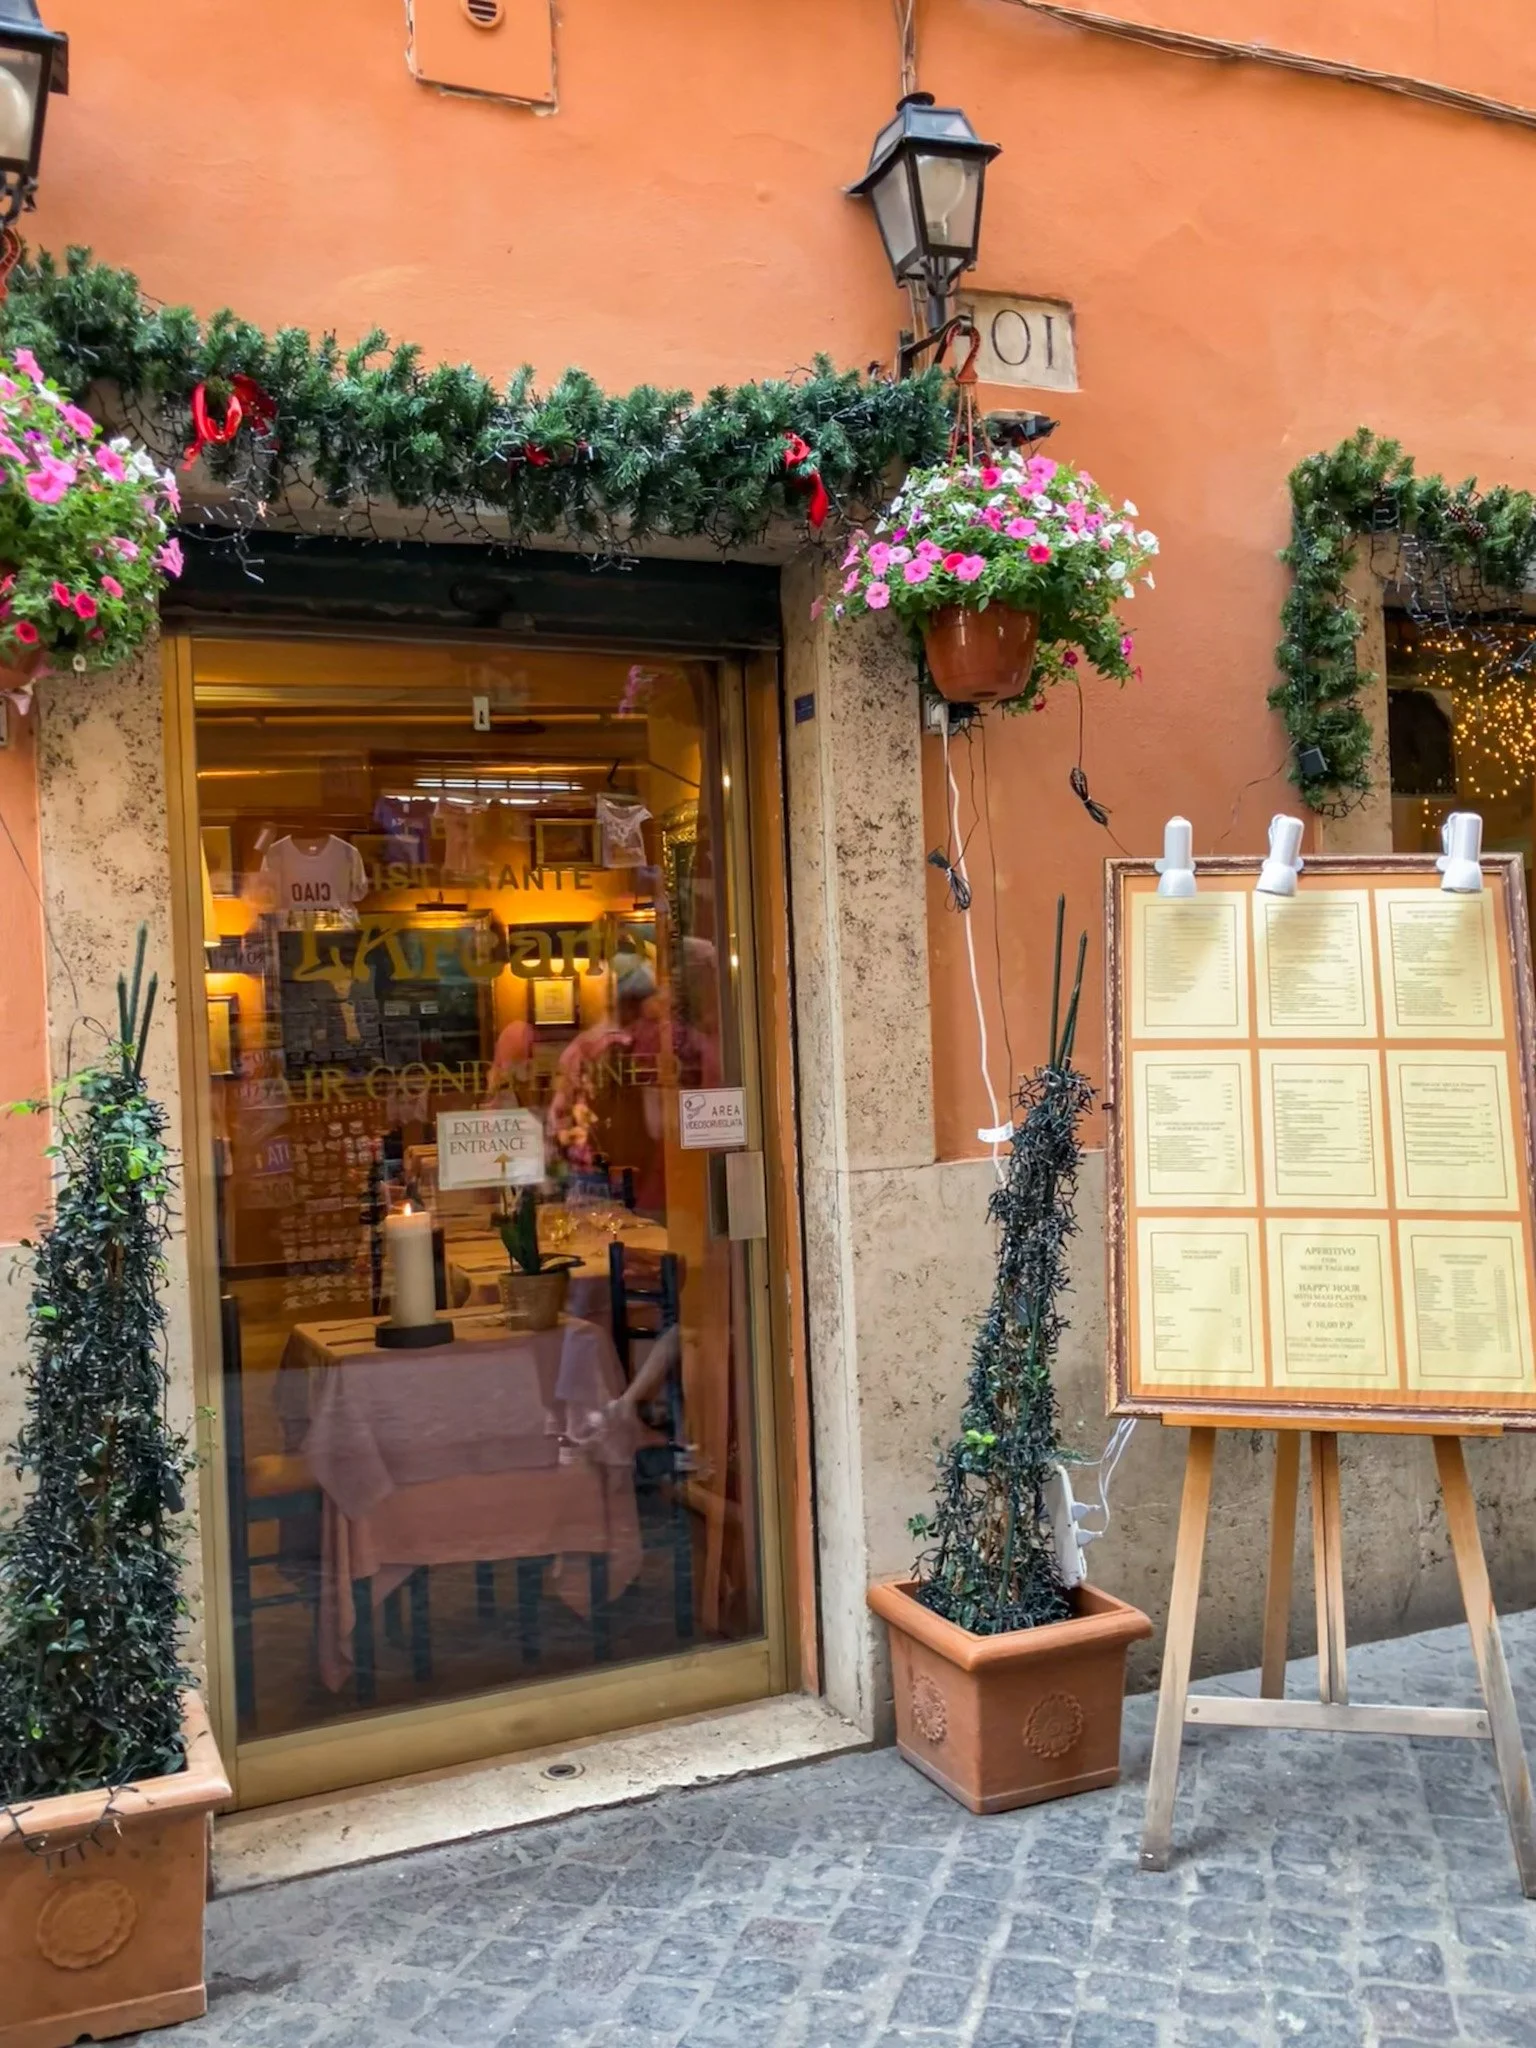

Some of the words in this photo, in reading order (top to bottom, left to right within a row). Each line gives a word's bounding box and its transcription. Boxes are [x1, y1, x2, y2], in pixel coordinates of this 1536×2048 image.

[711, 1105, 740, 1117] AREA
[453, 1118, 521, 1135] ENTRATA
[450, 1137, 528, 1155] ENTRANCE
[1305, 1247, 1356, 1256] APERITIVO
[1333, 1284, 1361, 1292] HOUR
